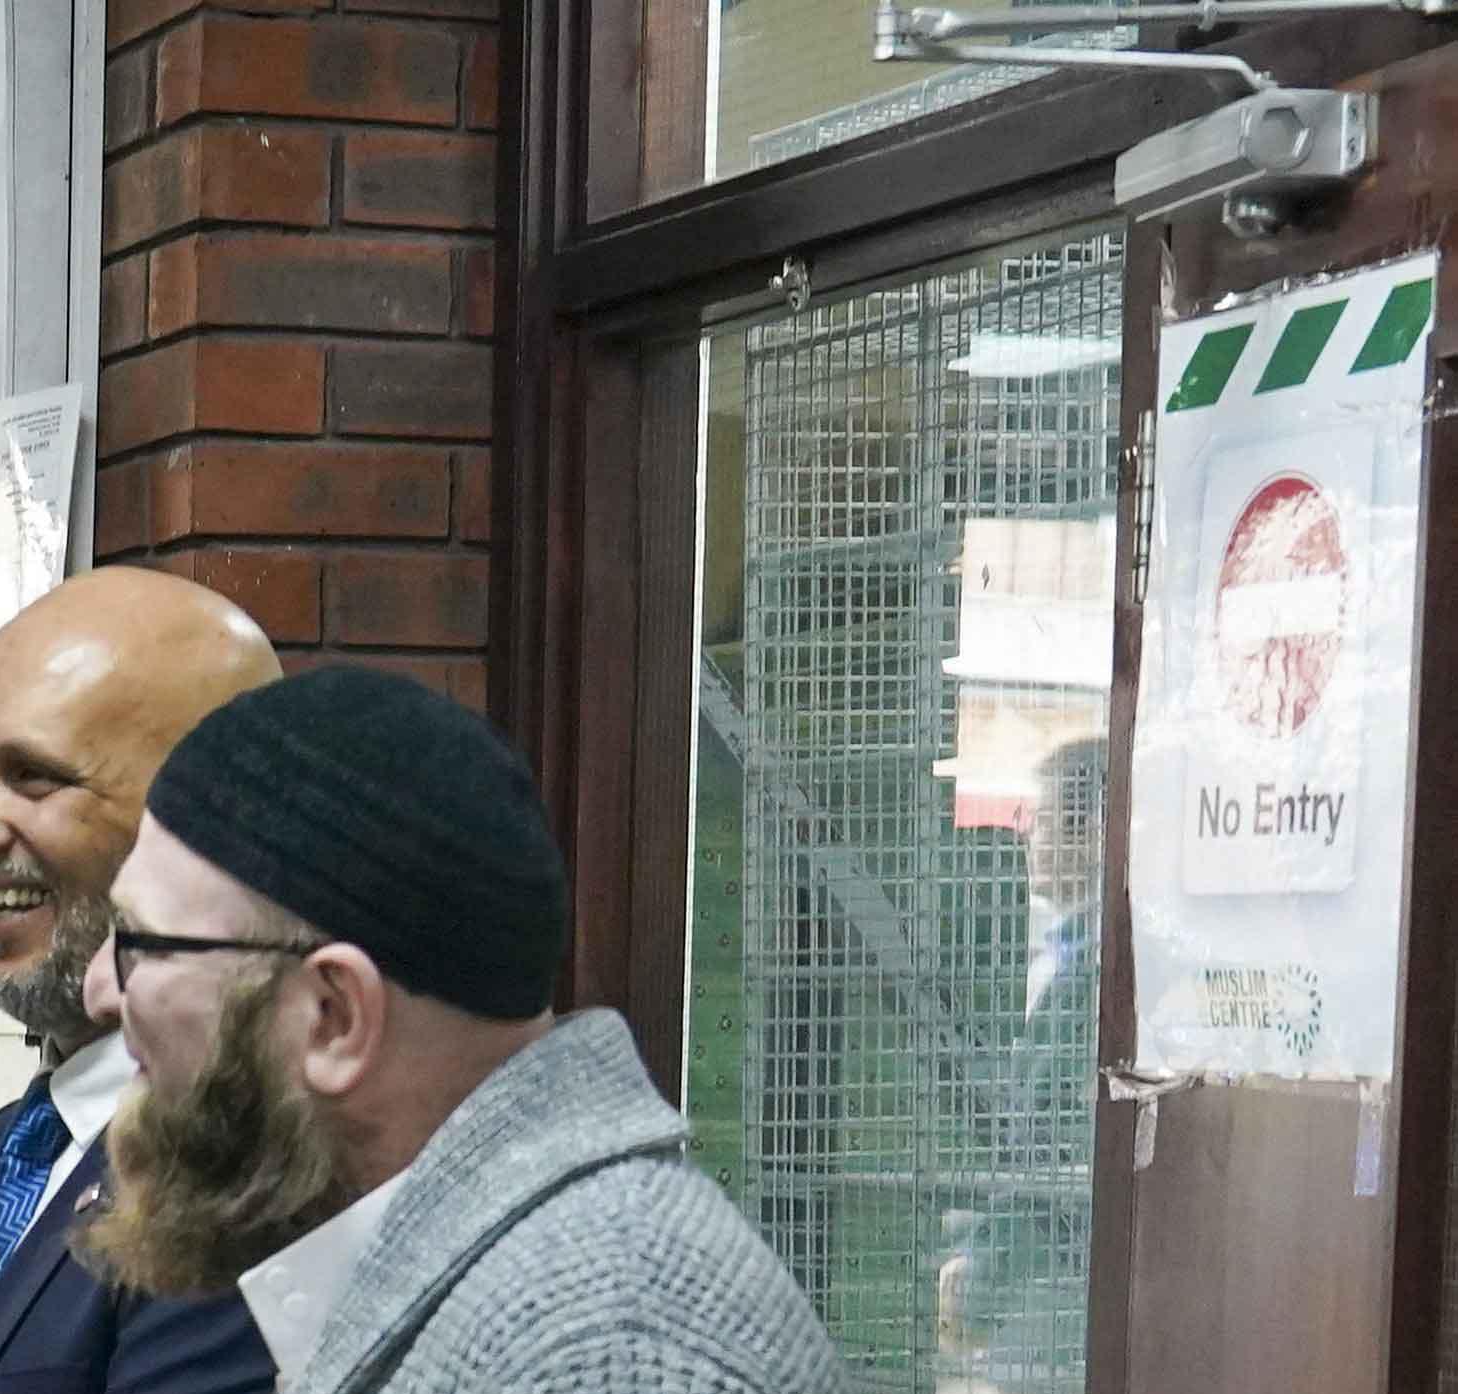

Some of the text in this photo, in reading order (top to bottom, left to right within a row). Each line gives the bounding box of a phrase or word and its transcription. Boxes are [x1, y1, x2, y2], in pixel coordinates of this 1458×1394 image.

[1199, 783, 1344, 846] No Entry
[1205, 969, 1269, 998] MUSLIM
[1209, 999, 1273, 1029] CENTRE
